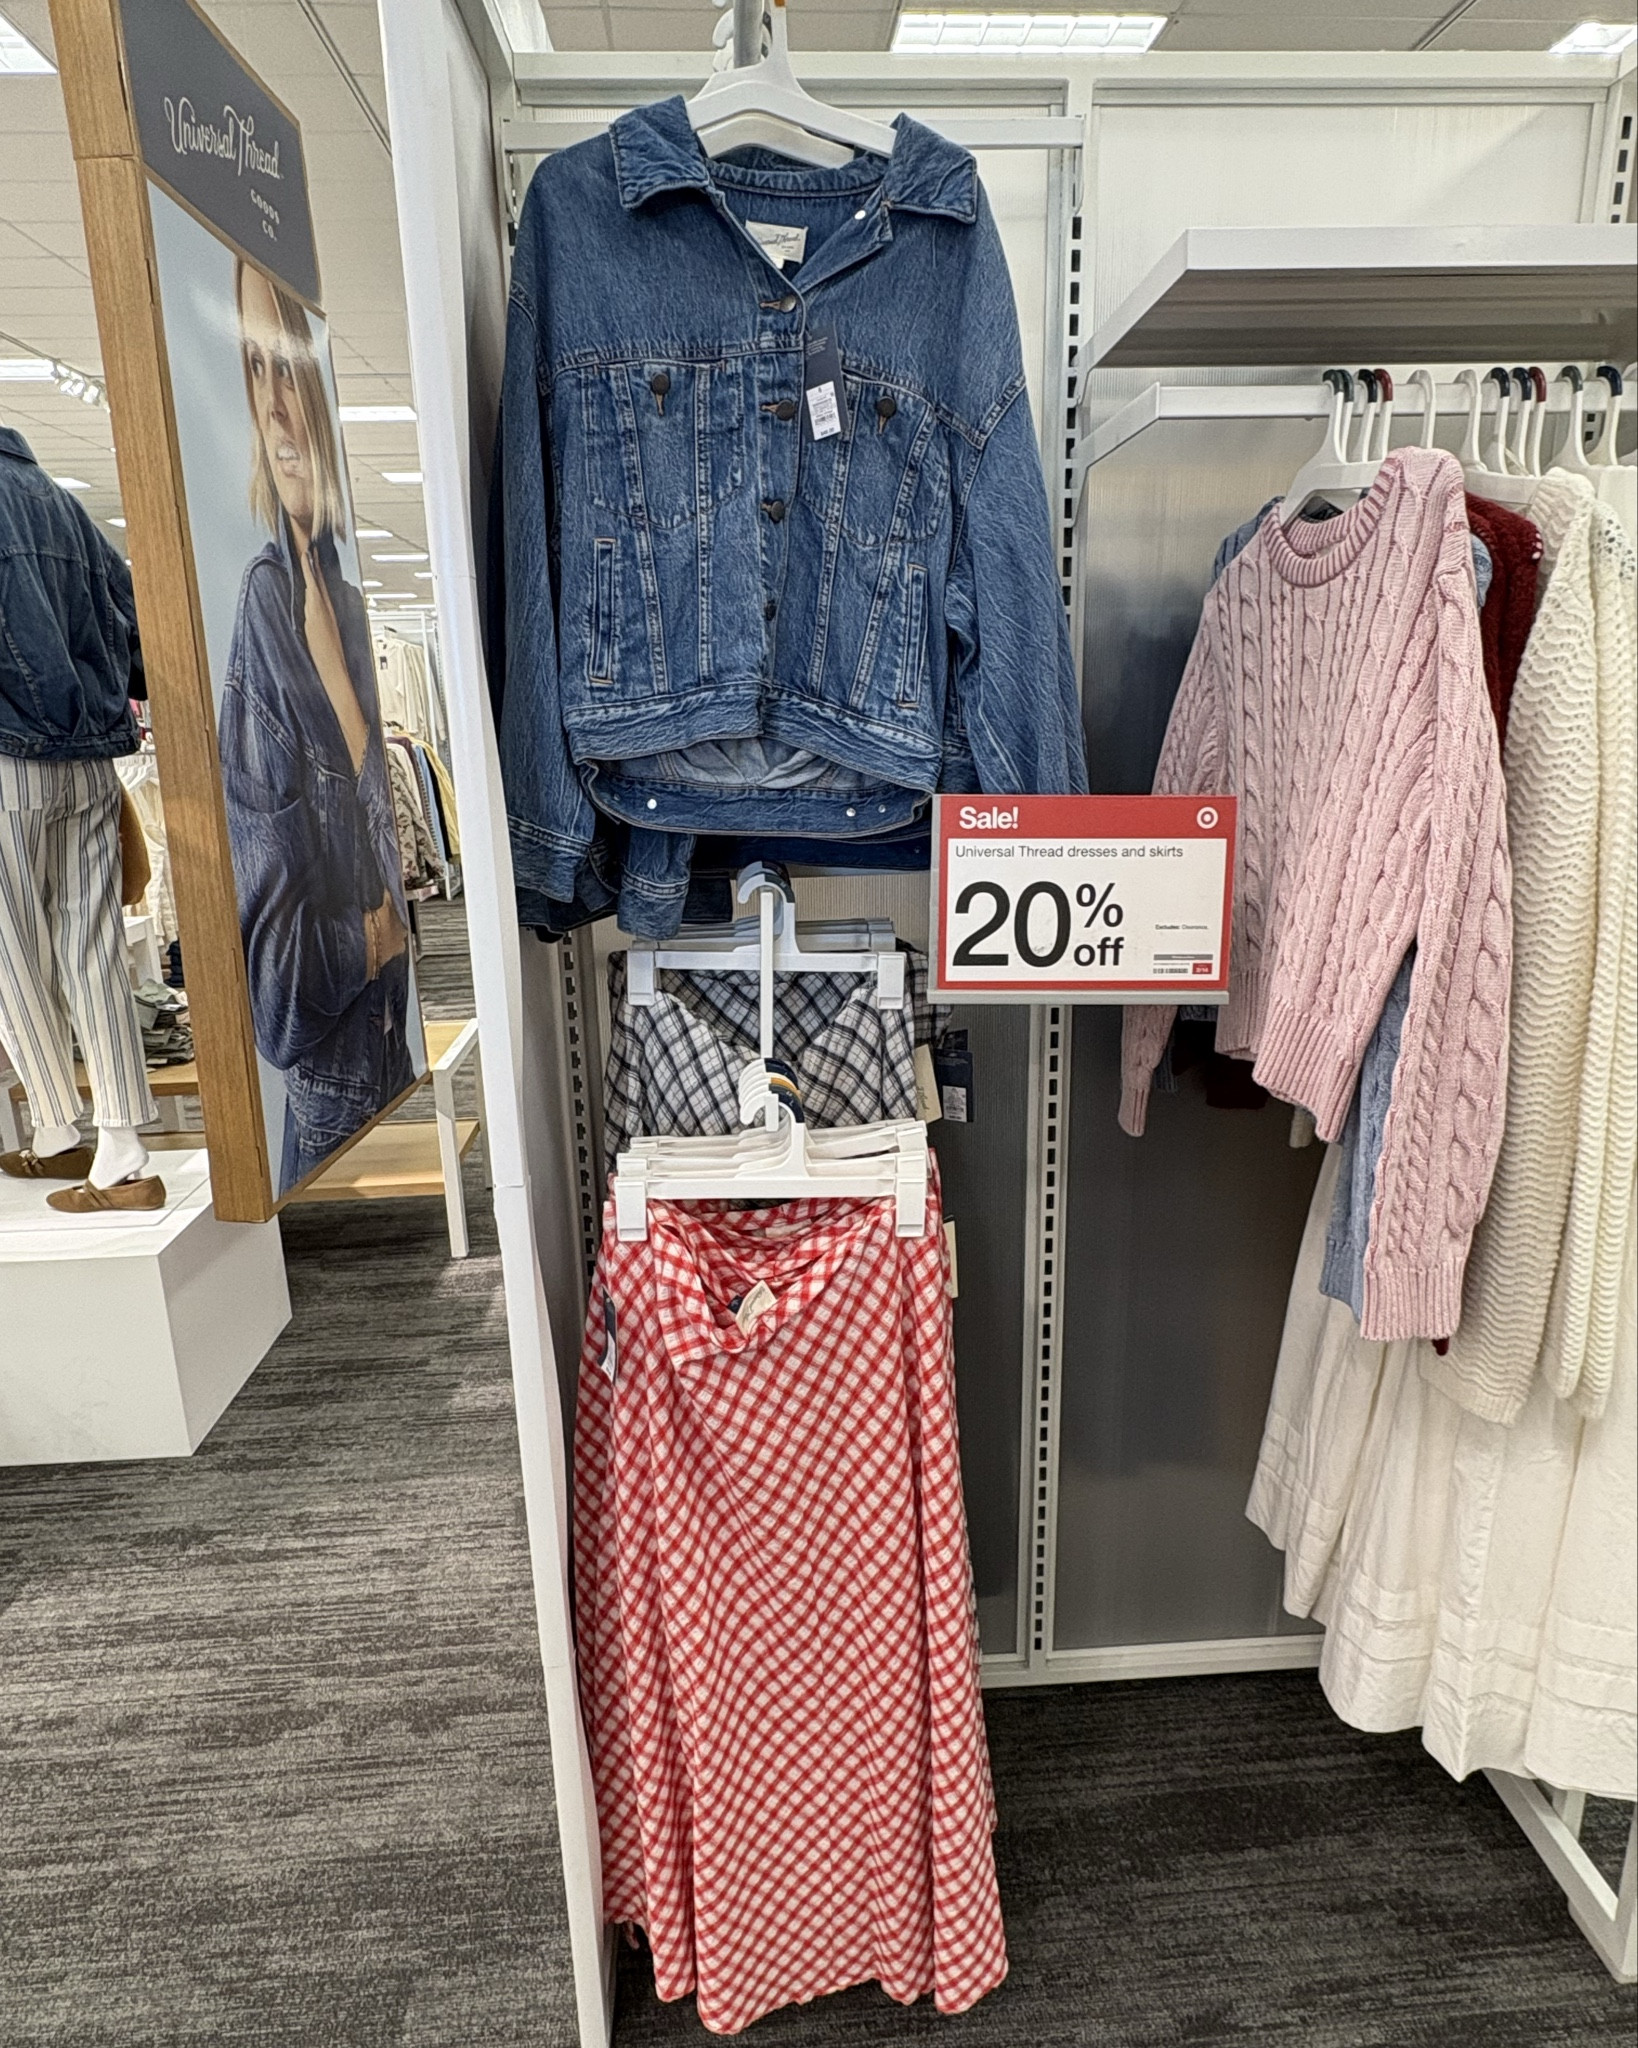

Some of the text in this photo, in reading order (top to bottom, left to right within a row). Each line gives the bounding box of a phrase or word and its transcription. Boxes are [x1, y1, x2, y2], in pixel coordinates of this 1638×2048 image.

[164, 96, 236, 160] Universal
[250, 188, 280, 225] GOODS
[959, 806, 1019, 830] Sale!
[955, 845, 1184, 858] Universal Thread dresses and skirts
[1073, 936, 1125, 967] off
